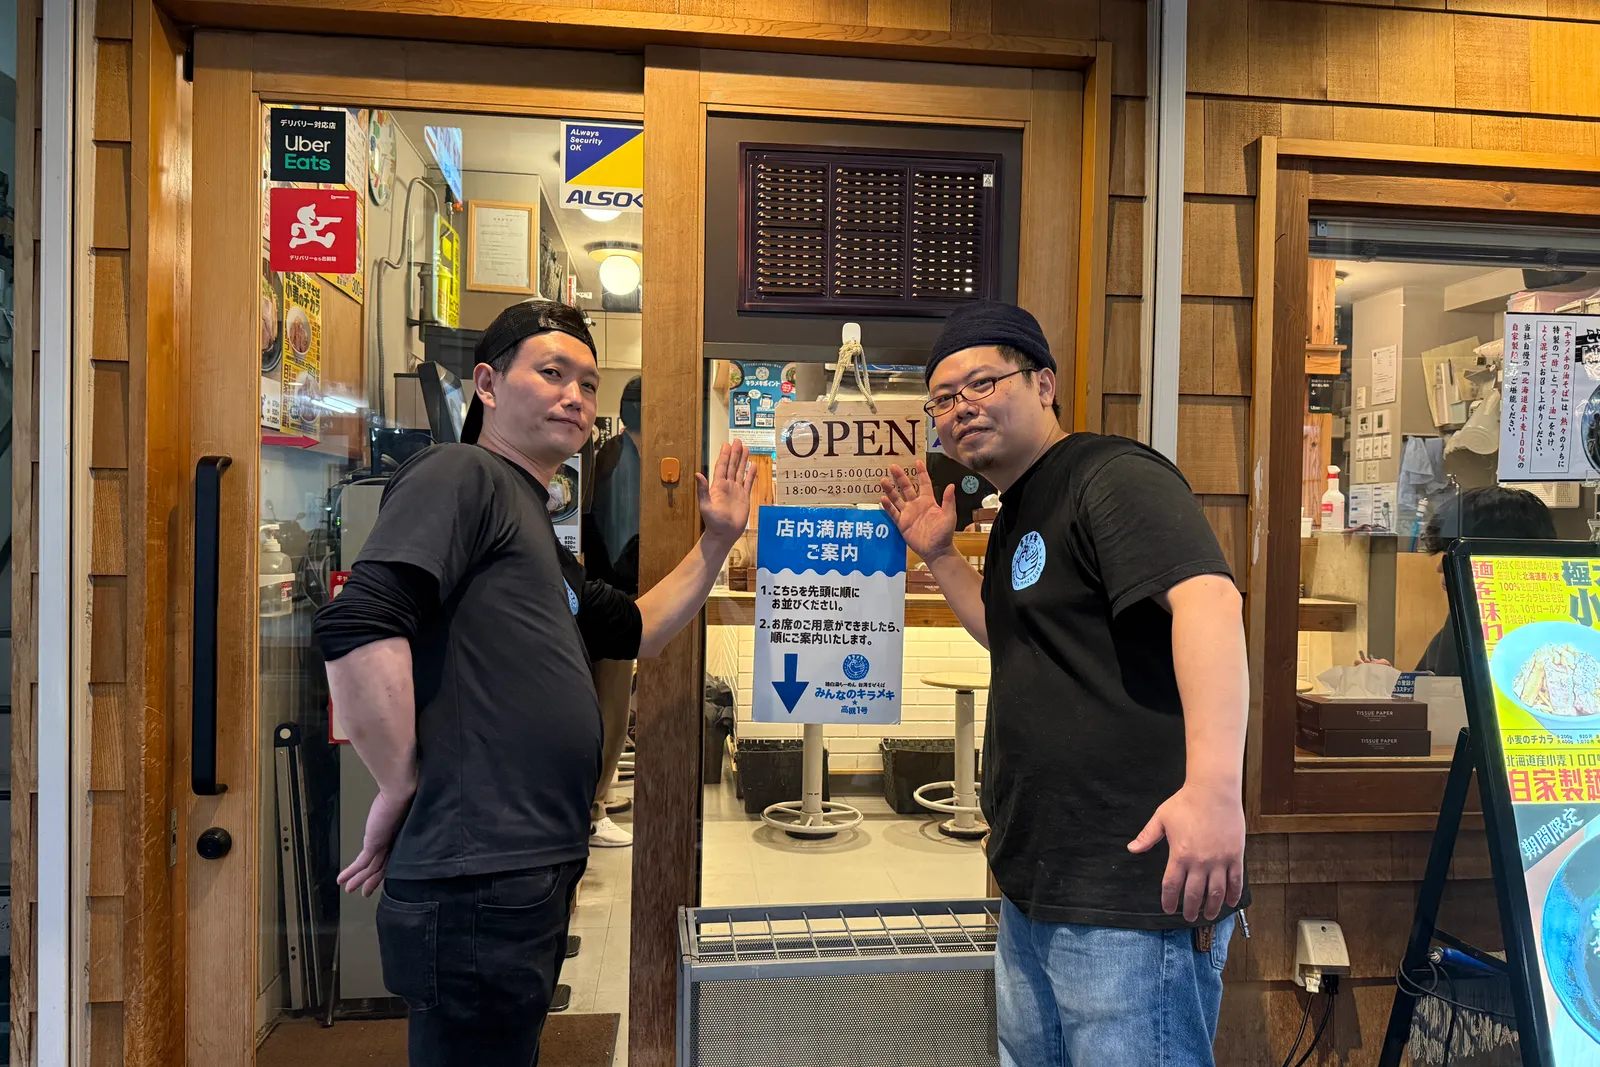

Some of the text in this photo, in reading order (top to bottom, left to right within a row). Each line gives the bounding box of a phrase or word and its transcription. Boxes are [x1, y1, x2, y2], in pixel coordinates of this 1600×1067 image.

[280, 119, 337, 130] デリバリー対応店
[570, 128, 600, 137] ALways
[284, 134, 331, 153] Uber
[569, 136, 603, 145] Security
[569, 143, 582, 152] OK
[284, 153, 331, 172] Eats
[1535, 325, 1548, 457] よく混ぜてお召し上がりください。
[785, 419, 920, 458] OPEN
[776, 518, 889, 540] 店内満席時の
[806, 543, 859, 562] ご案内
[771, 598, 844, 612] お並びください。
[770, 632, 873, 646] 順にご案内いたします。
[814, 687, 895, 701] みんなのキラメキ
[1506, 734, 1554, 745] 小麦のチカラ
[1521, 807, 1584, 860] 期間限定
